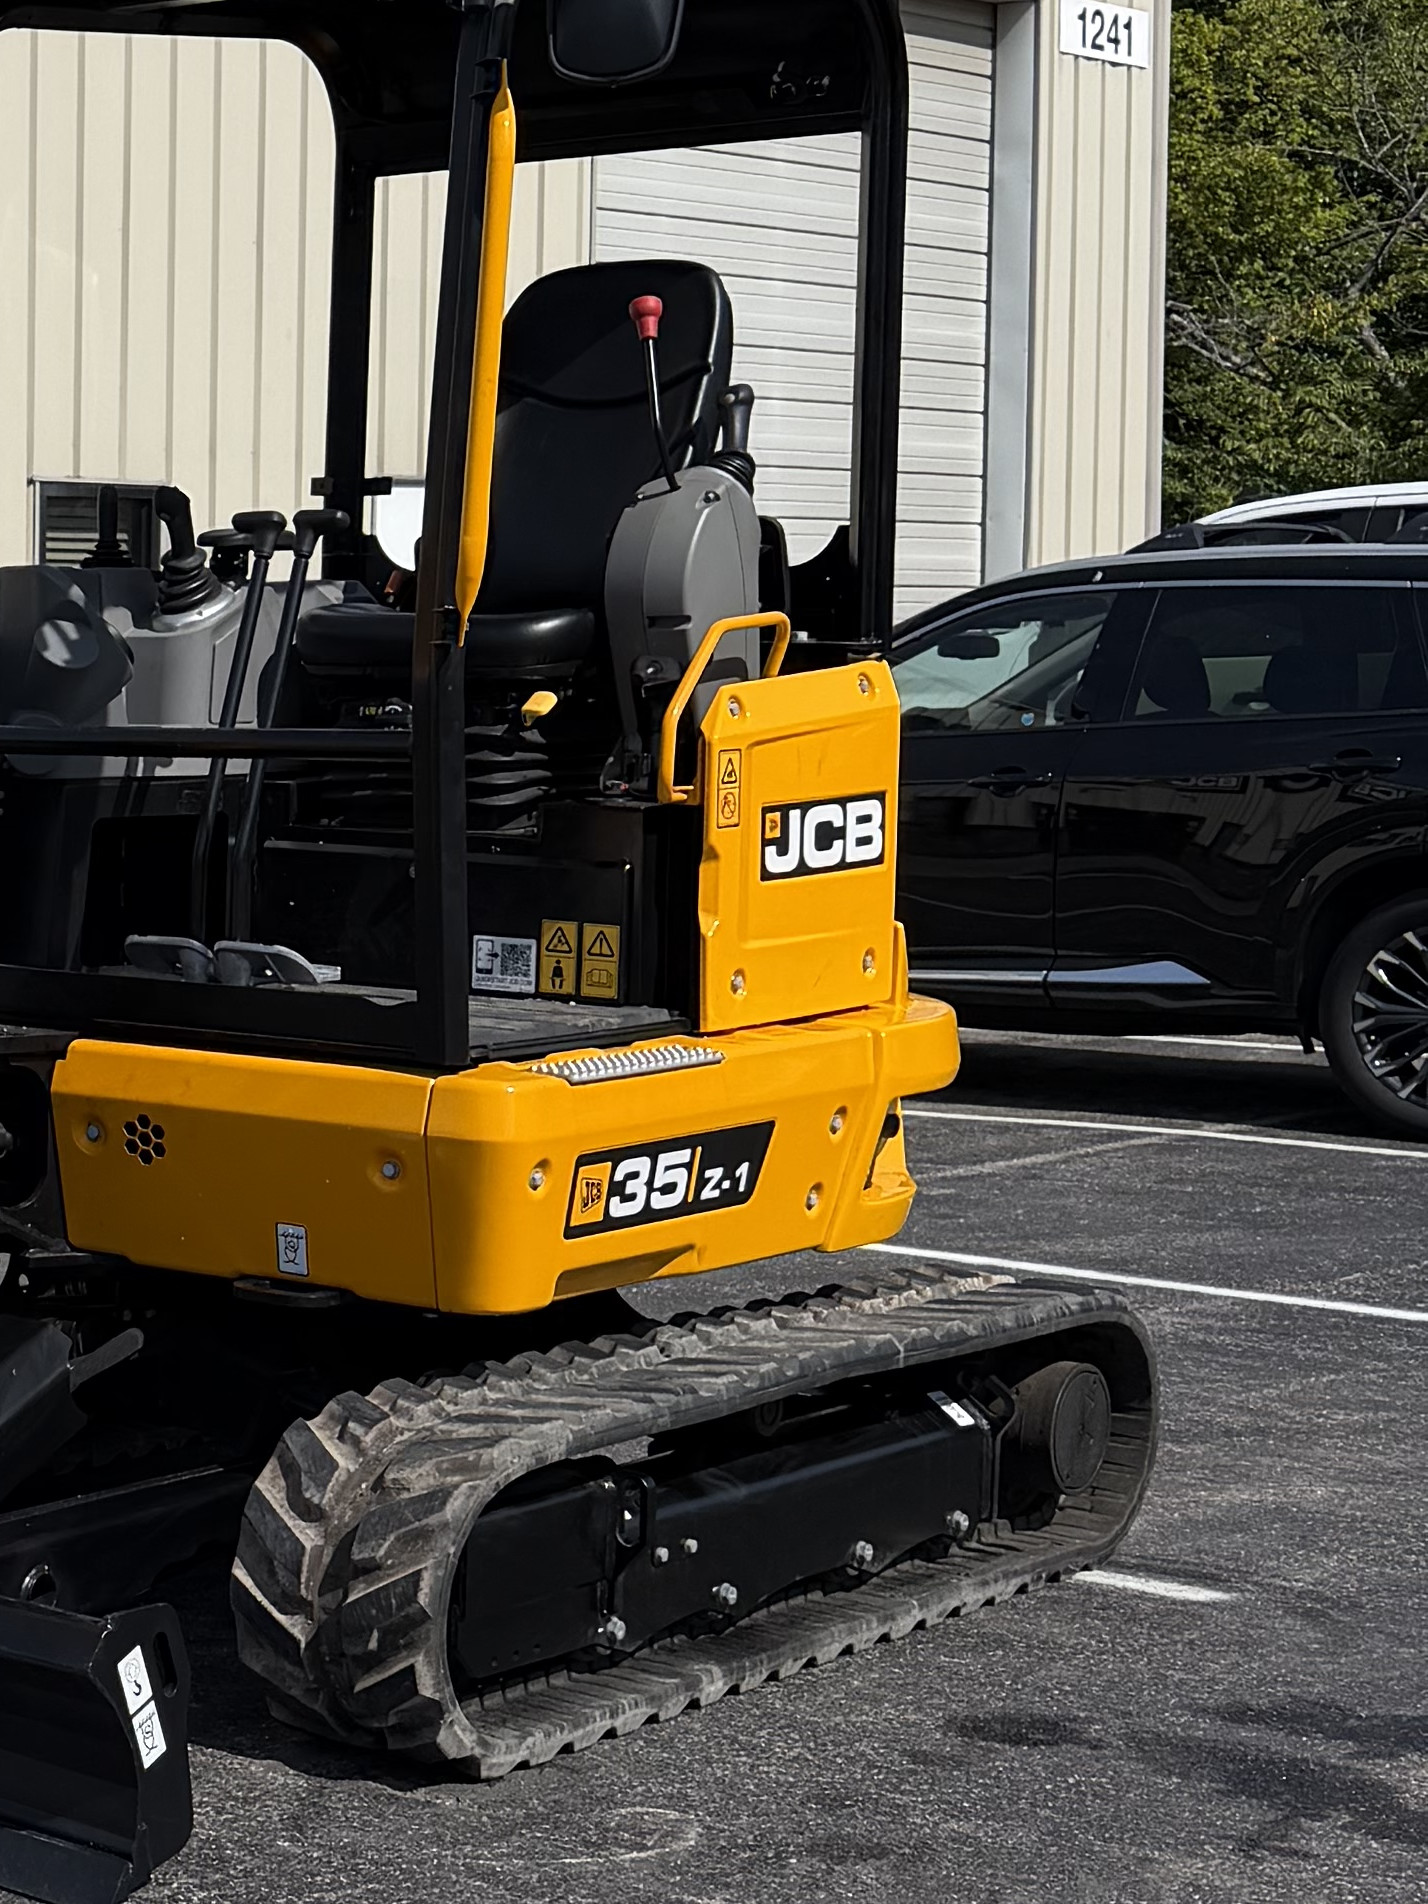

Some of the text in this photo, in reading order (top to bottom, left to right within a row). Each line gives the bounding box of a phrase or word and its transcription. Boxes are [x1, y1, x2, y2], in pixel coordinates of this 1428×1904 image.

[1077, 7, 1133, 57] 1241
[764, 799, 883, 874] JCB
[608, 1148, 692, 1218] 35
